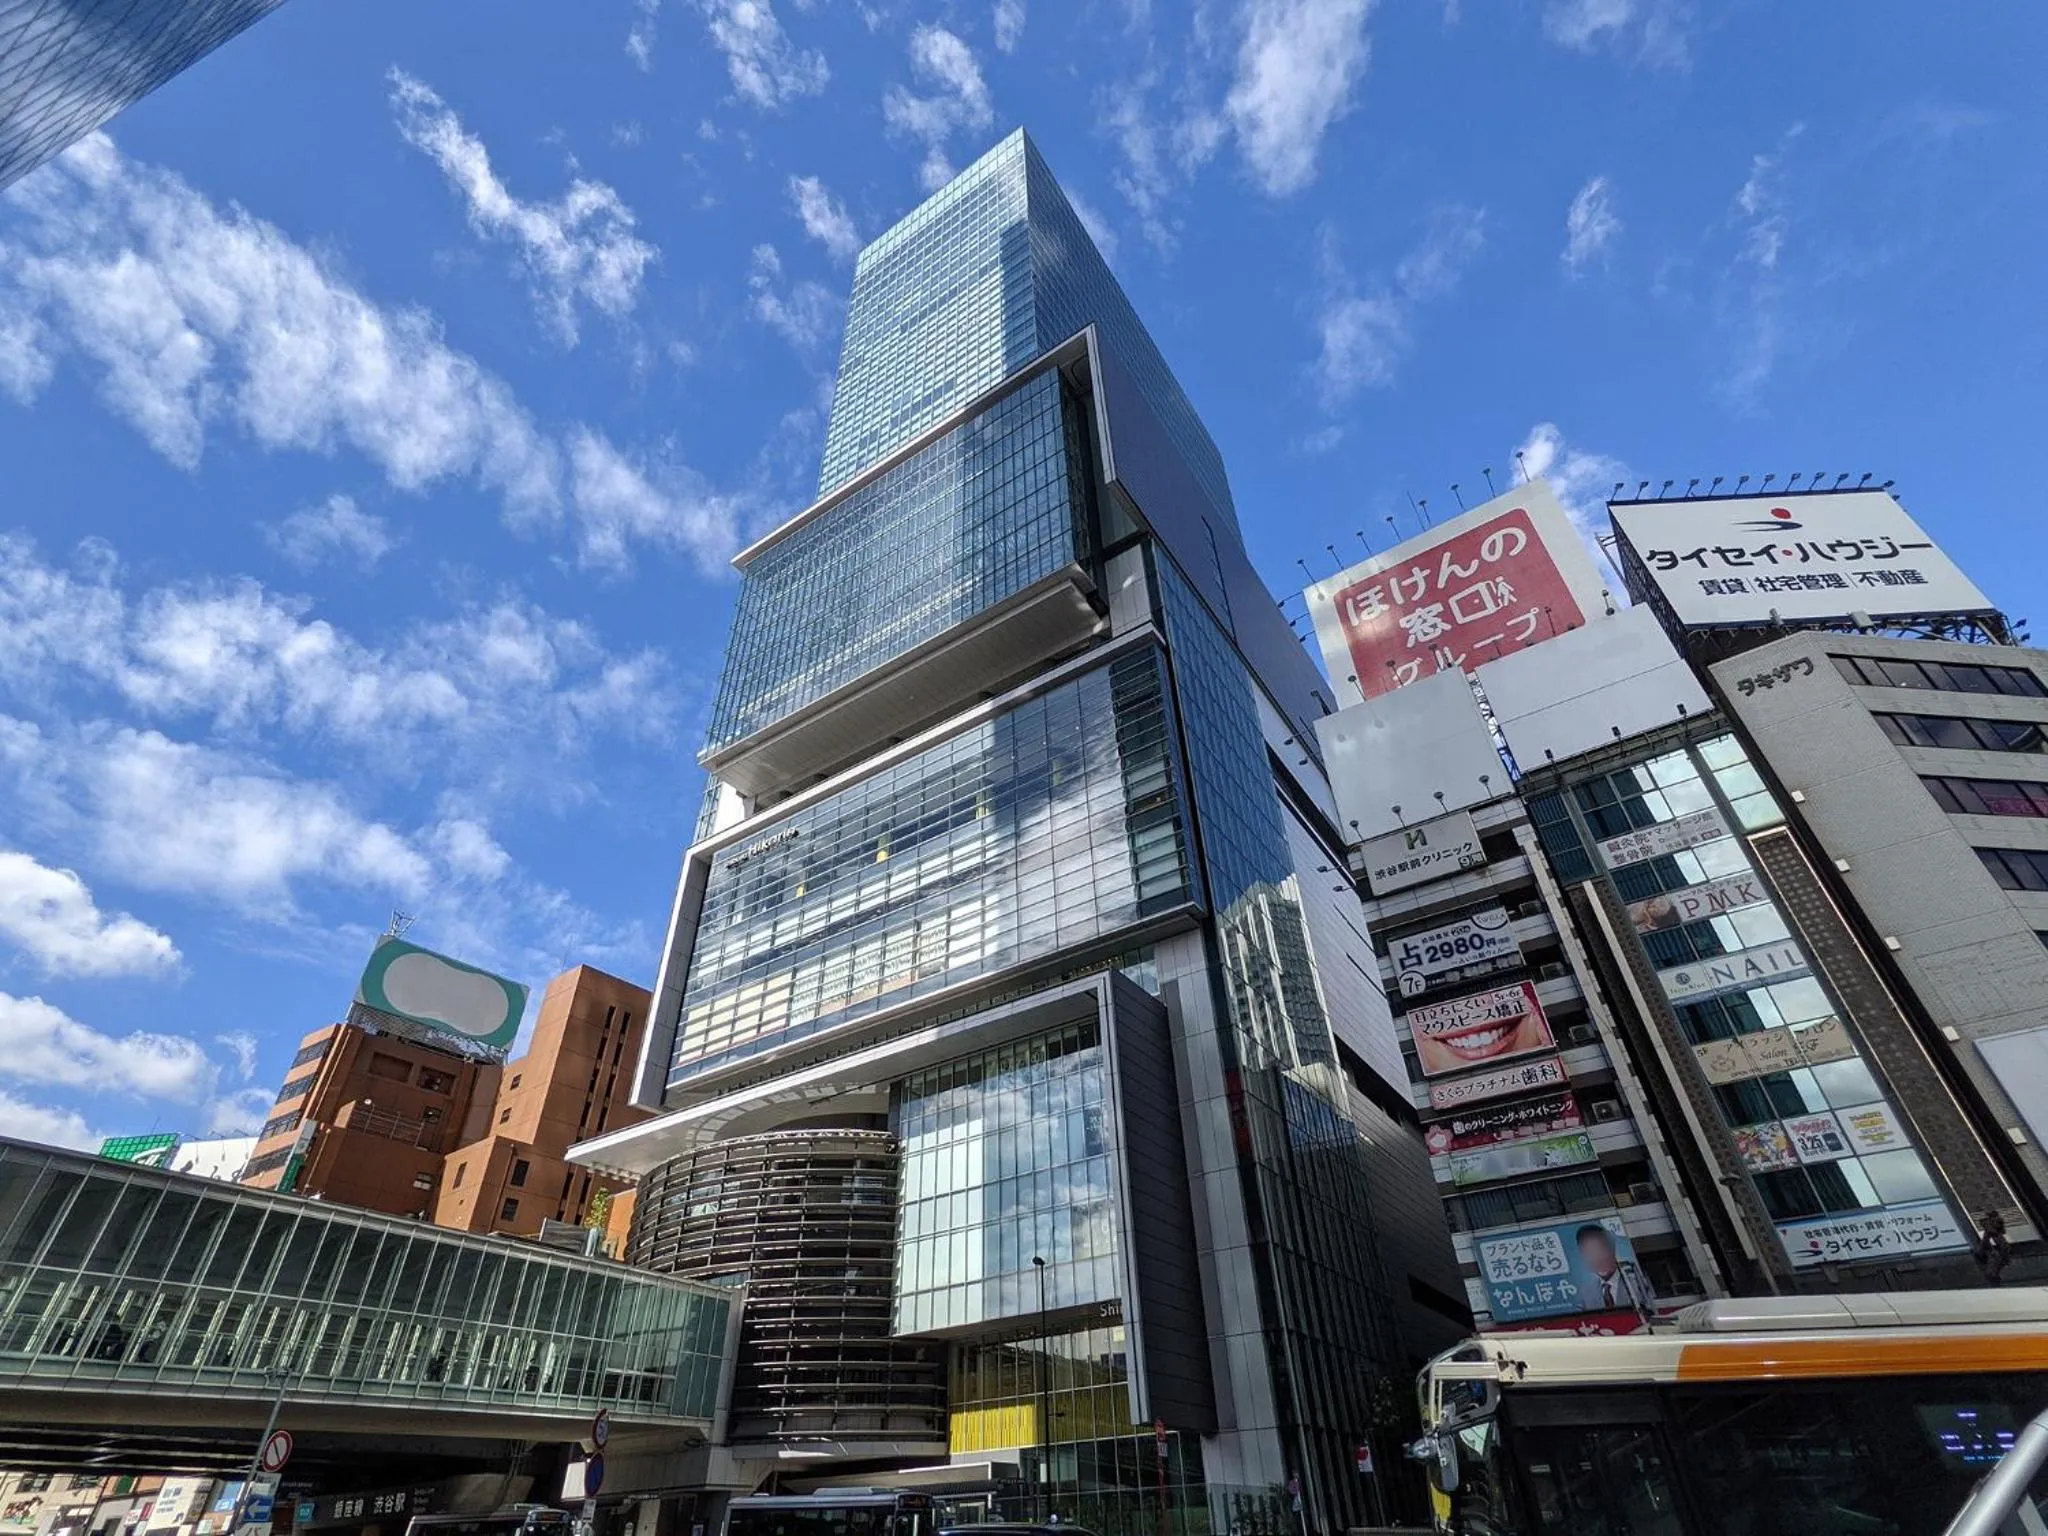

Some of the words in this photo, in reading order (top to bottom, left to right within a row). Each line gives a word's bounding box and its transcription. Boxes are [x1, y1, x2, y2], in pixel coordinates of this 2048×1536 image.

[1646, 535, 1933, 571] タイセイ・ハウジー
[1346, 526, 1528, 626] ほけんの
[1698, 576, 1750, 596] 賃貸
[1755, 572, 1850, 593] 社宅管理
[1857, 568, 1928, 587] 不動産
[1399, 578, 1505, 648] 窓口
[1391, 607, 1540, 689] グループ
[1736, 655, 1815, 697] タキザワ
[1374, 842, 1473, 880] 渋谷駅前クリニック
[1680, 881, 1762, 918] PMK
[1425, 933, 1496, 964] 2980円
[1711, 948, 1804, 985] NAIL
[1404, 977, 1421, 993] 7F
[1415, 996, 1487, 1024] 目立ちにくい
[1420, 1001, 1526, 1035] マウスピース矯正
[1760, 1049, 1787, 1061] Salon
[1435, 1063, 1558, 1102] さくらプラチナム歯科
[1452, 1100, 1573, 1135] 歯のクリーニング・ホワイトニング
[1486, 1236, 1557, 1257] ブランド品を
[1825, 1226, 1956, 1255] タイセイ・ハウジー
[1491, 1251, 1563, 1279] 売るなら
[1493, 1279, 1578, 1308] なんぼや
